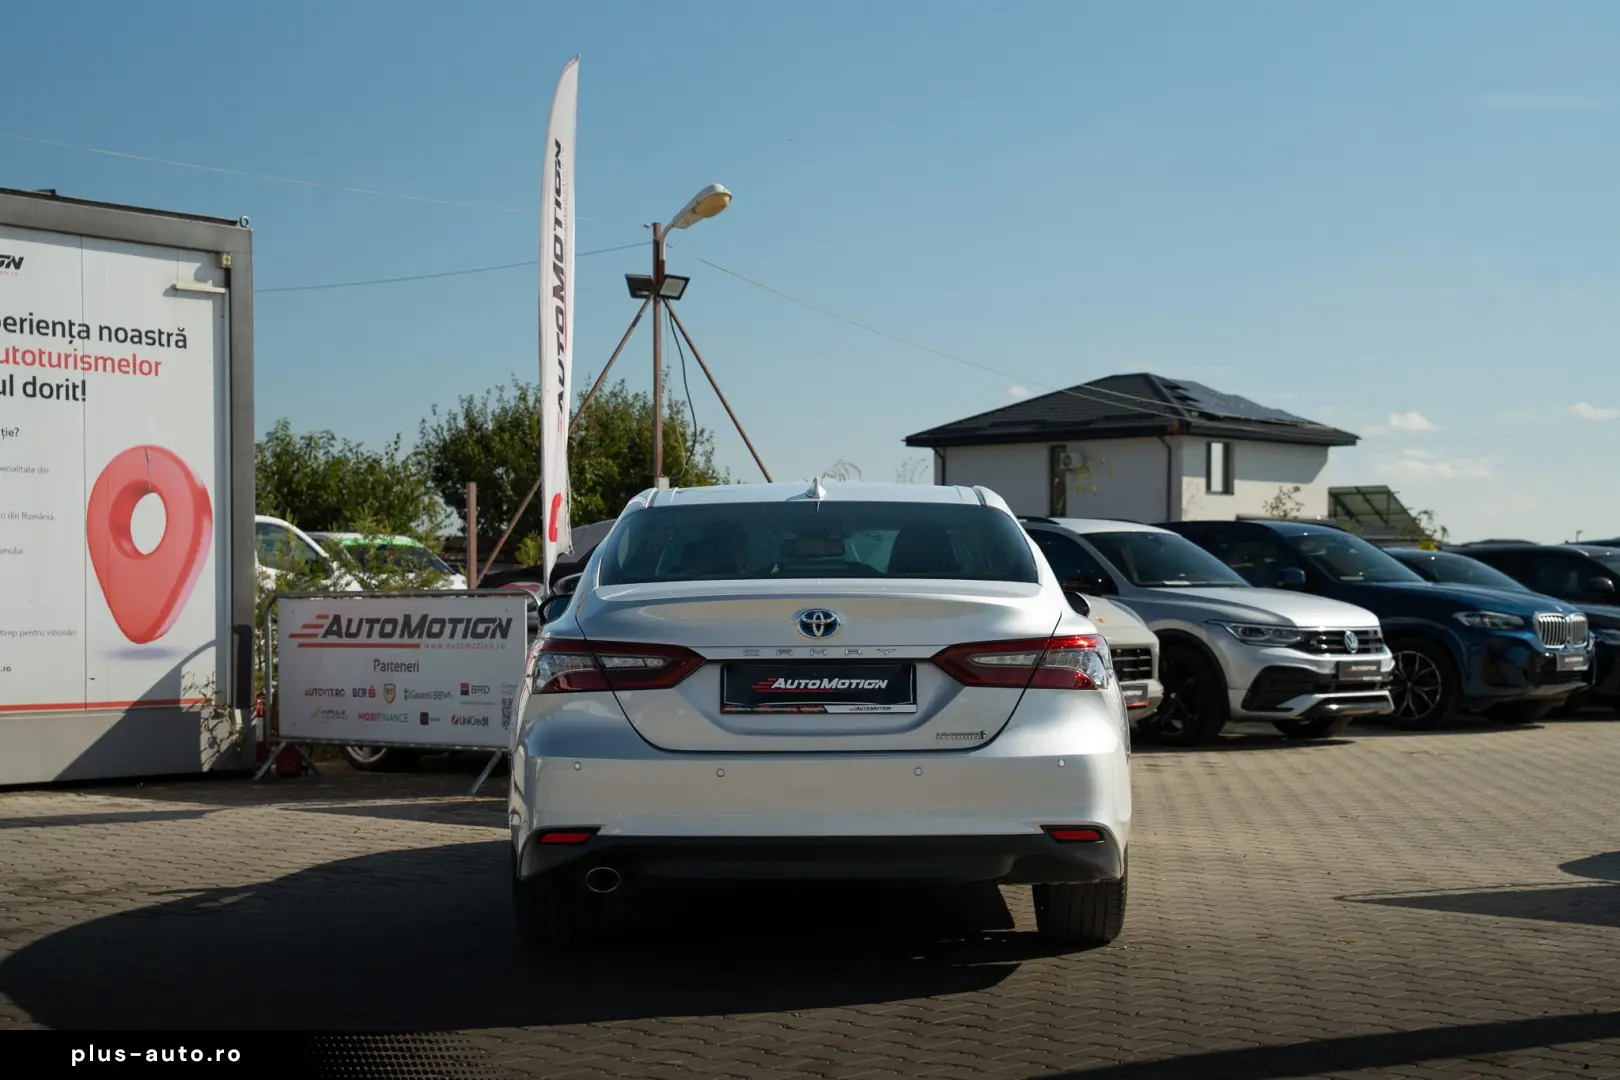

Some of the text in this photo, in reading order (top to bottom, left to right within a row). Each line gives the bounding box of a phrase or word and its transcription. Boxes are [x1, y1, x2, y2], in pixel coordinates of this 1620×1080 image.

[0, 312, 187, 349] eriența noastră
[22, 376, 86, 402] dorit!
[321, 614, 513, 640] AUTOMOTION
[743, 649, 897, 657] CAMRY
[373, 659, 420, 672] Parteneri
[470, 685, 490, 694] BRD
[770, 677, 889, 690] AUTOMOTION
[352, 687, 367, 698] BCR
[459, 715, 489, 727] UniCredit
